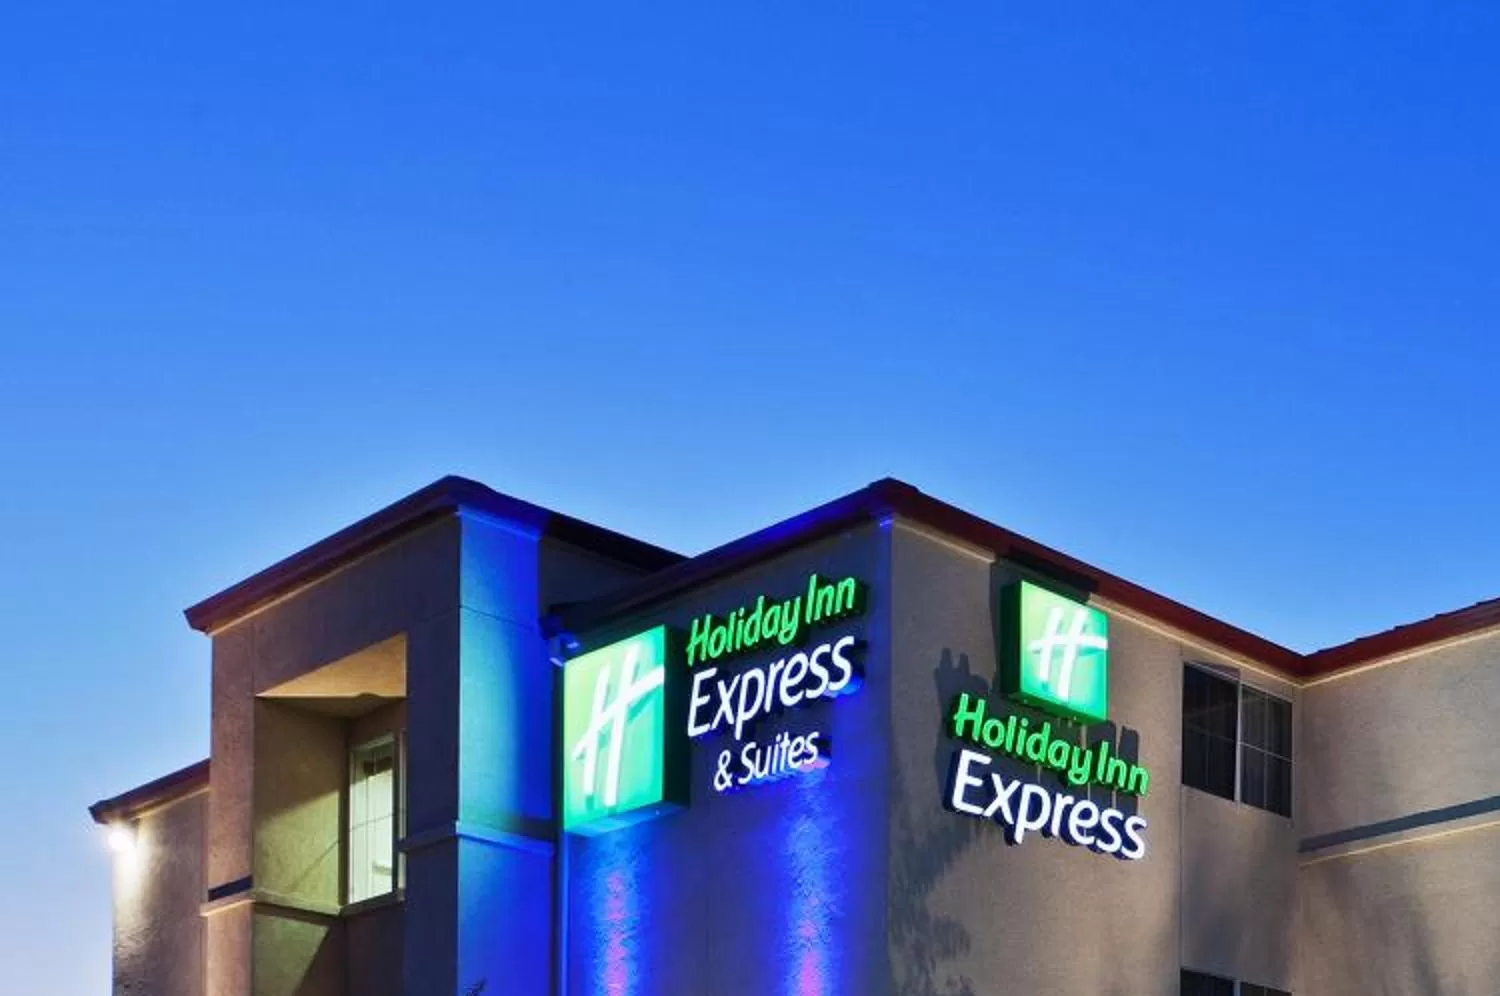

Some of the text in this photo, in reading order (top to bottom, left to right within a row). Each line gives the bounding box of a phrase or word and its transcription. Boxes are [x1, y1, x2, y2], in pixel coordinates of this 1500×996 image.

[686, 573, 856, 666] Holiday Inn
[687, 635, 855, 740] Express
[713, 731, 819, 791] & Suites
[953, 693, 1149, 796] Holiday Inn
[953, 749, 1148, 859] Express
